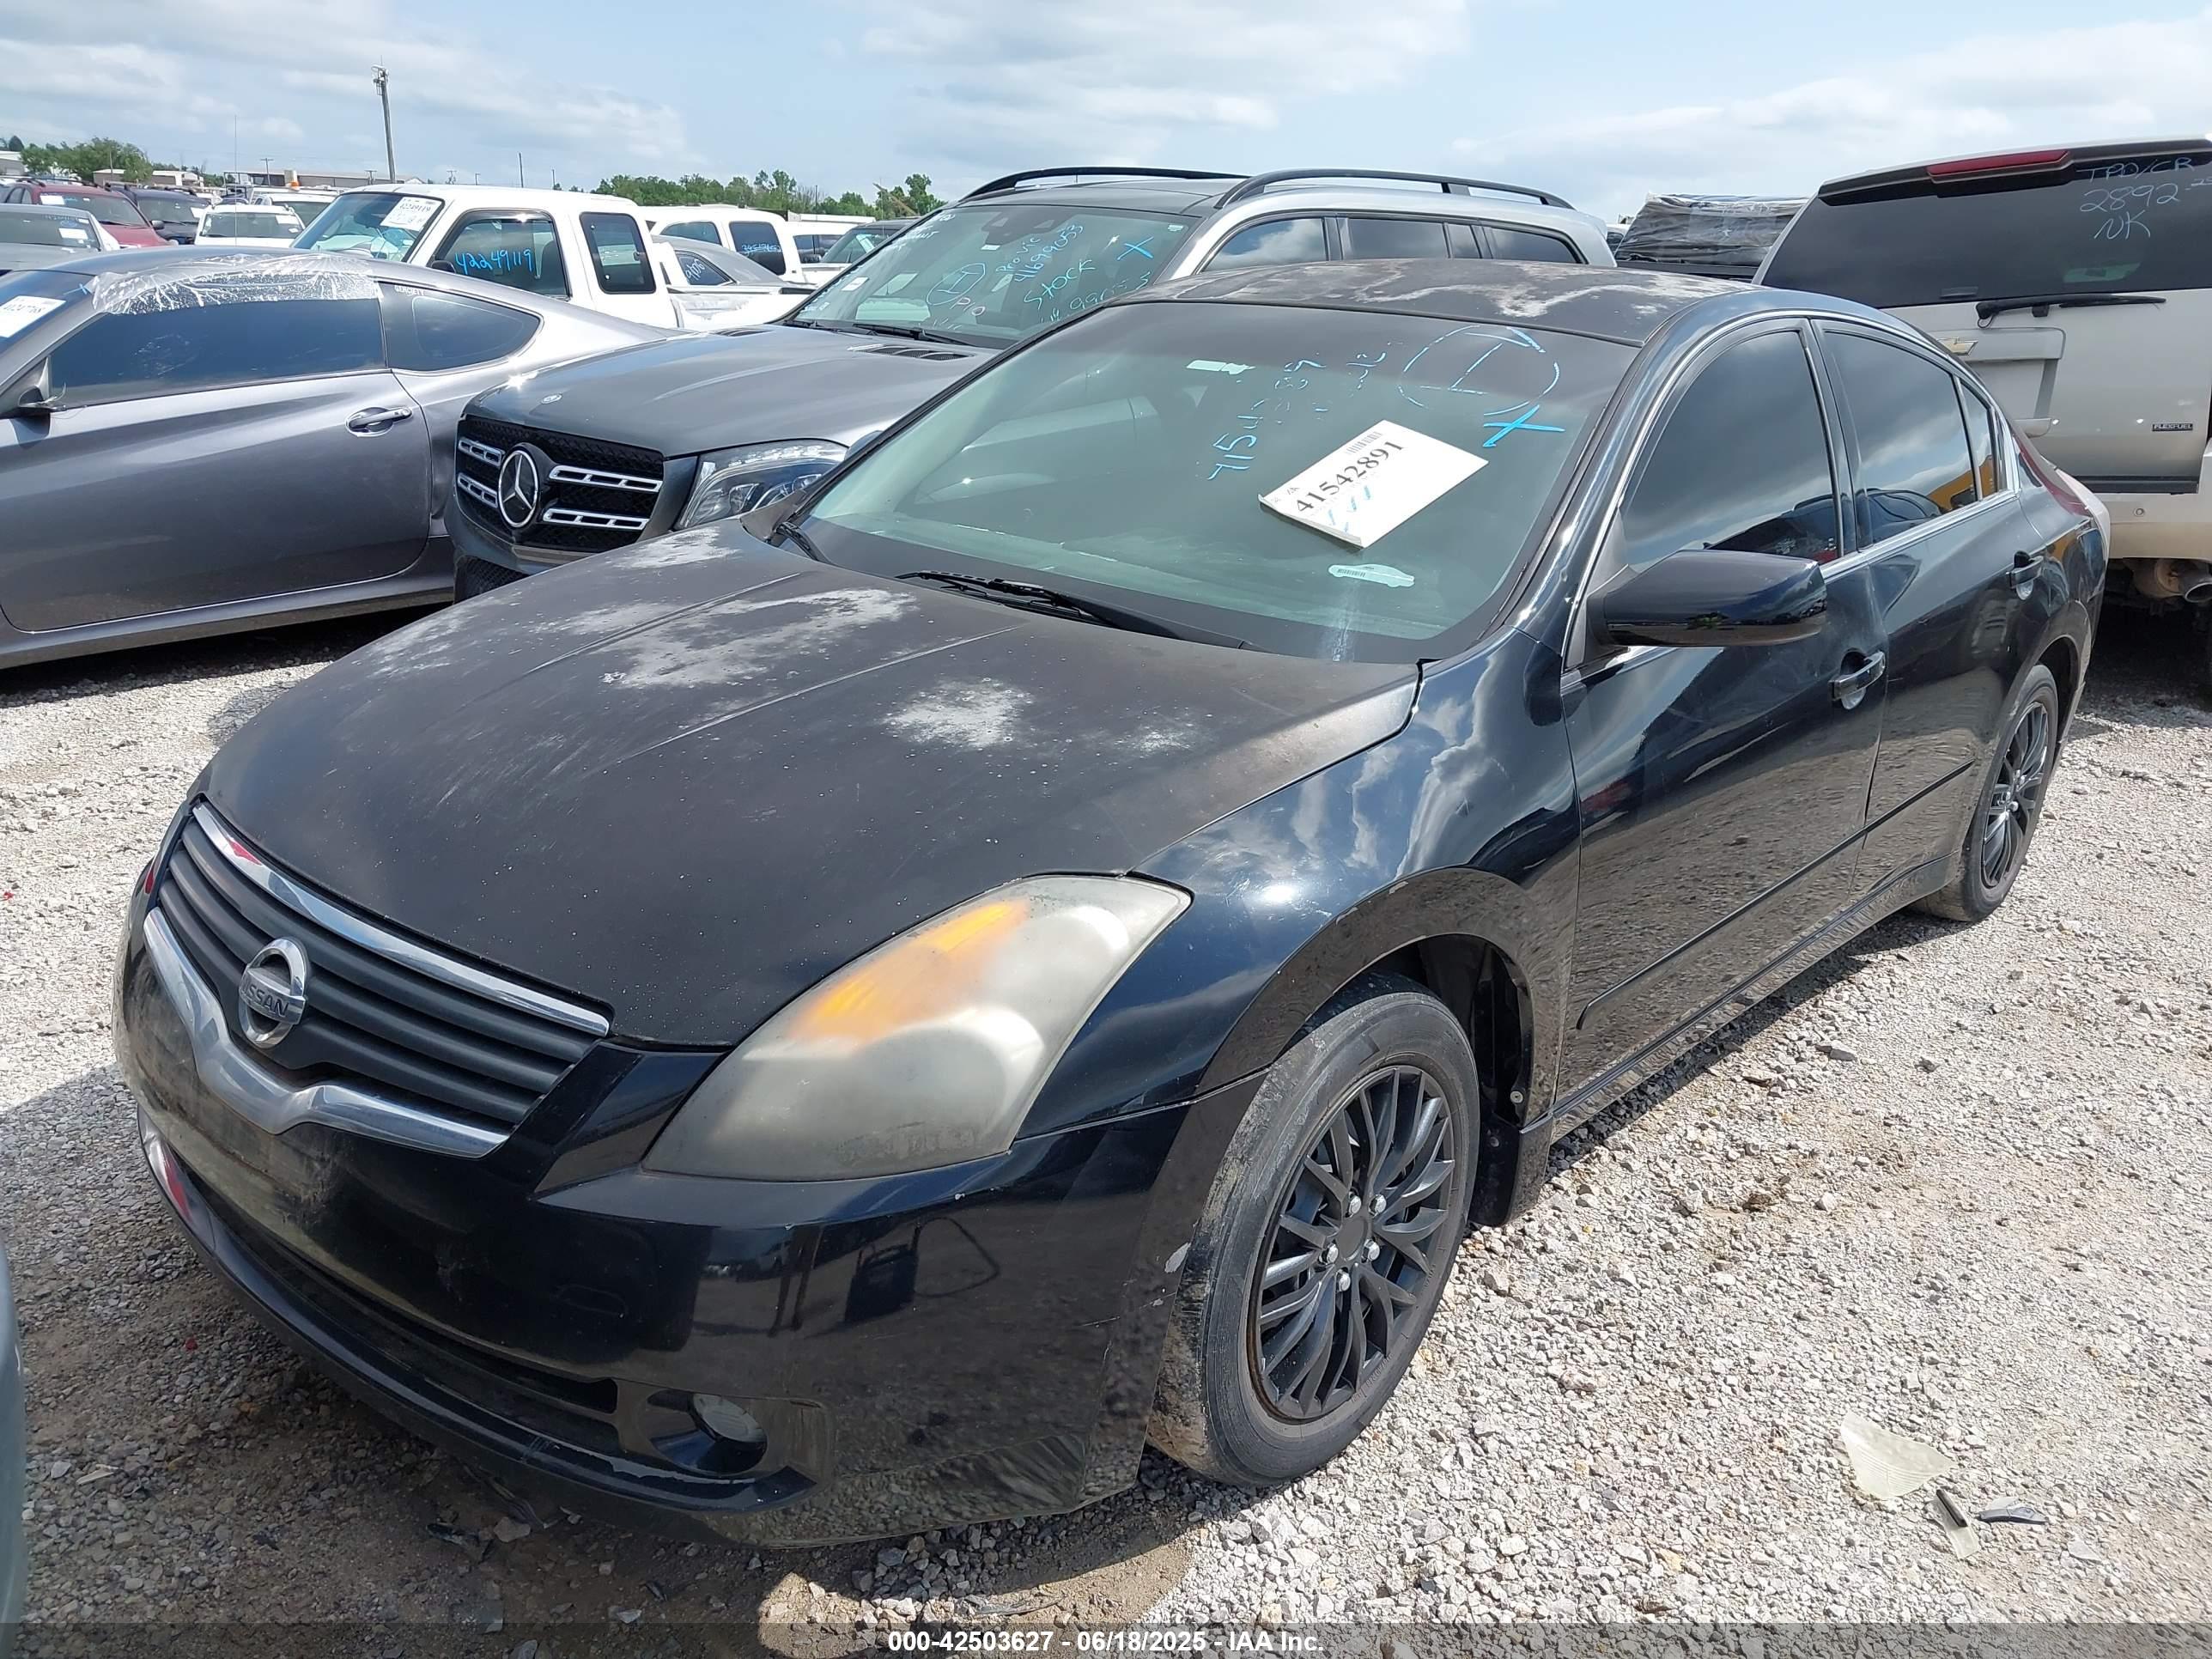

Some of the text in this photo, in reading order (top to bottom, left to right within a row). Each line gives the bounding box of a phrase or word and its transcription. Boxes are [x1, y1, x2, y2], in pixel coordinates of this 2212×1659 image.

[2080, 183, 2181, 212] 2892
[2094, 210, 2151, 240] NK
[454, 248, 537, 276] 42249119
[1296, 440, 1405, 513] 41542891
